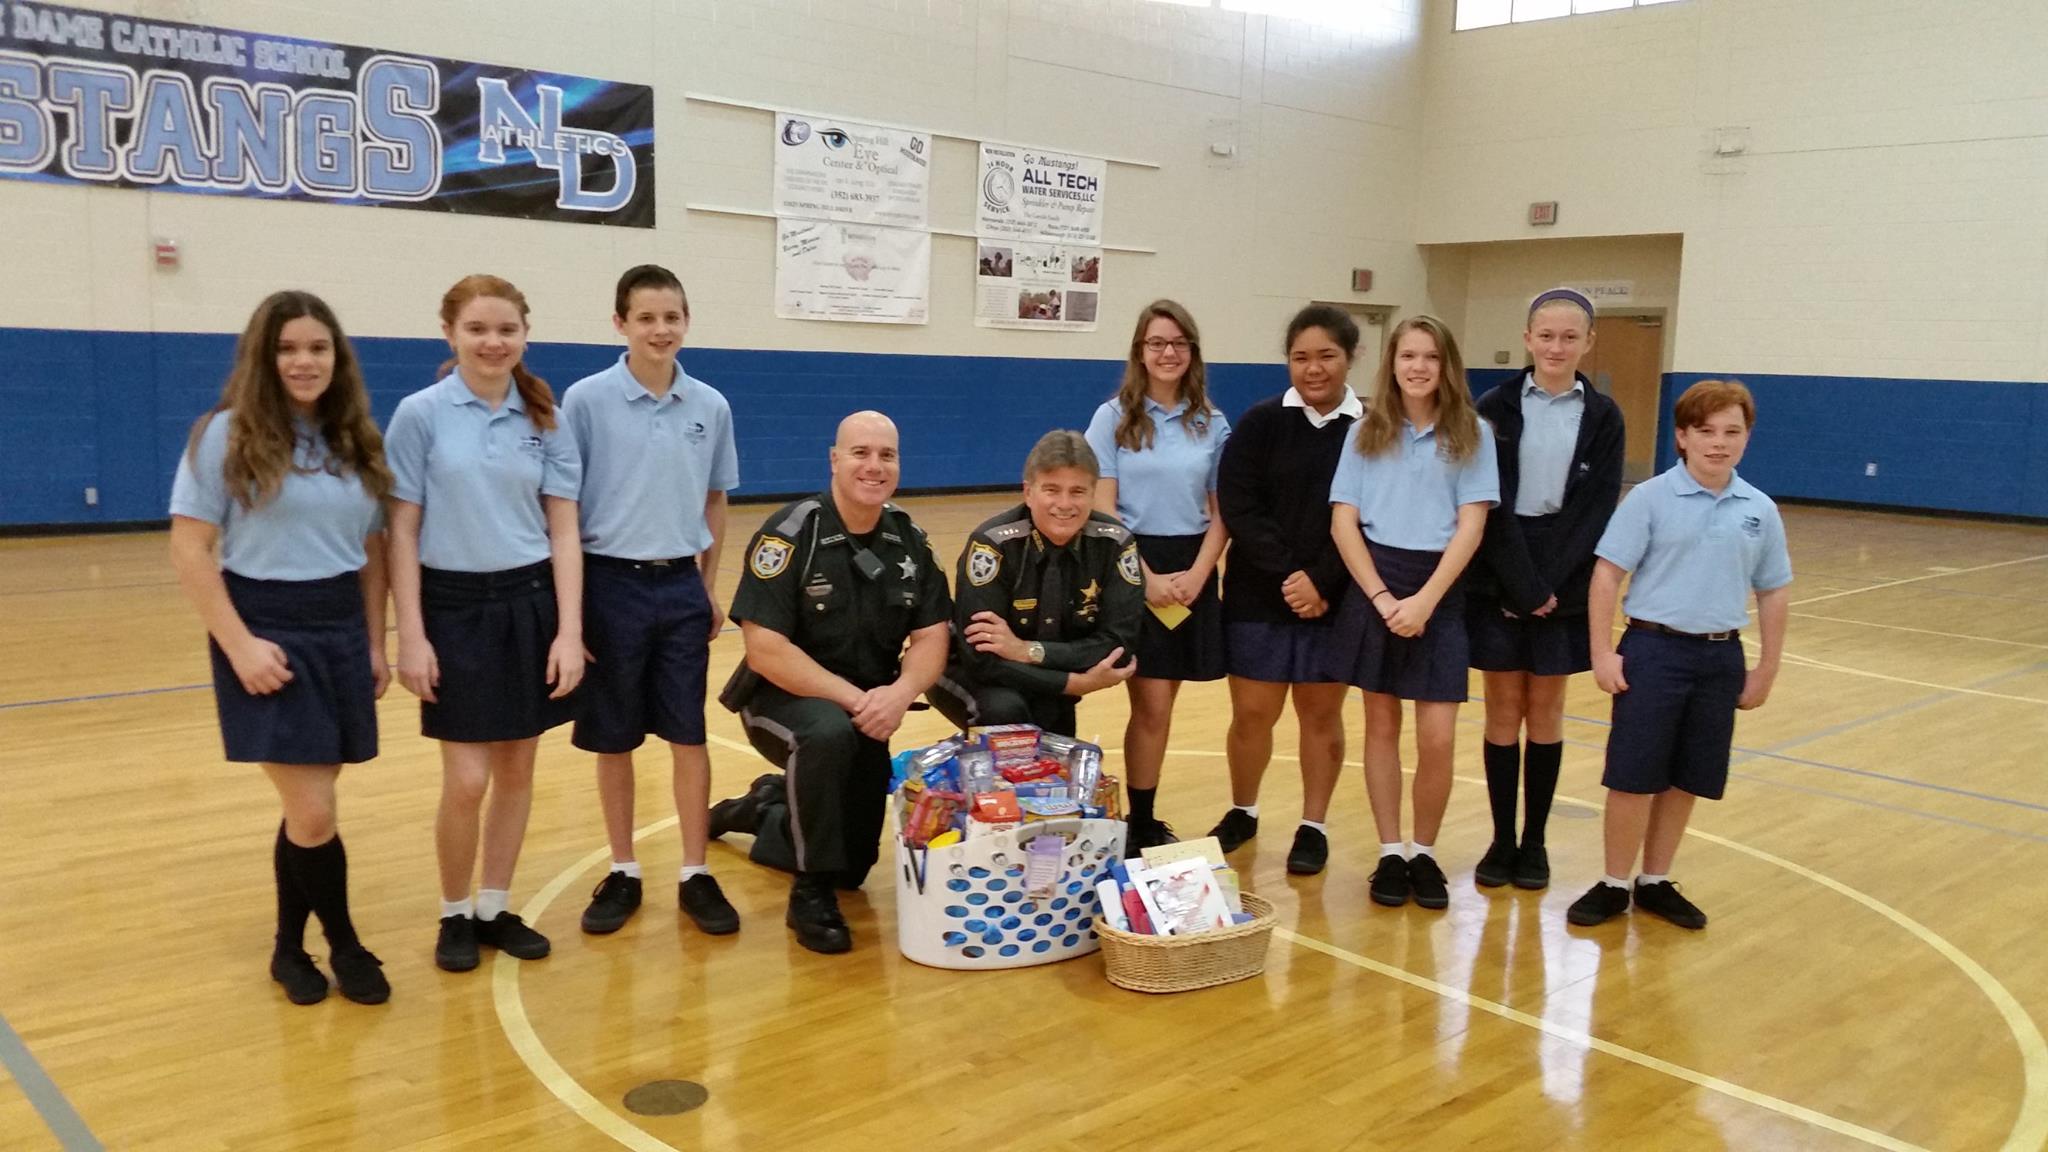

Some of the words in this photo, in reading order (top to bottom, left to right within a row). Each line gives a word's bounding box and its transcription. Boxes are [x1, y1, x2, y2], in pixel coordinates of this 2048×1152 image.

[12, 4, 105, 50] DAME
[110, 20, 246, 67] CATHOLIC
[253, 39, 351, 79] SCHOOL
[483, 124, 627, 157] ATHLETICS
[910, 136, 924, 154] GO
[853, 143, 880, 161] Eye
[822, 156, 853, 169] Center
[867, 161, 898, 175] Optical
[995, 160, 1014, 173] HOUR
[1023, 153, 1035, 165] Go
[1038, 155, 1079, 171] Mustangs!
[1022, 168, 1052, 186] ALL
[1057, 172, 1098, 191] TECH
[1022, 185, 1047, 197] WATER
[983, 201, 1010, 214] SERVICE
